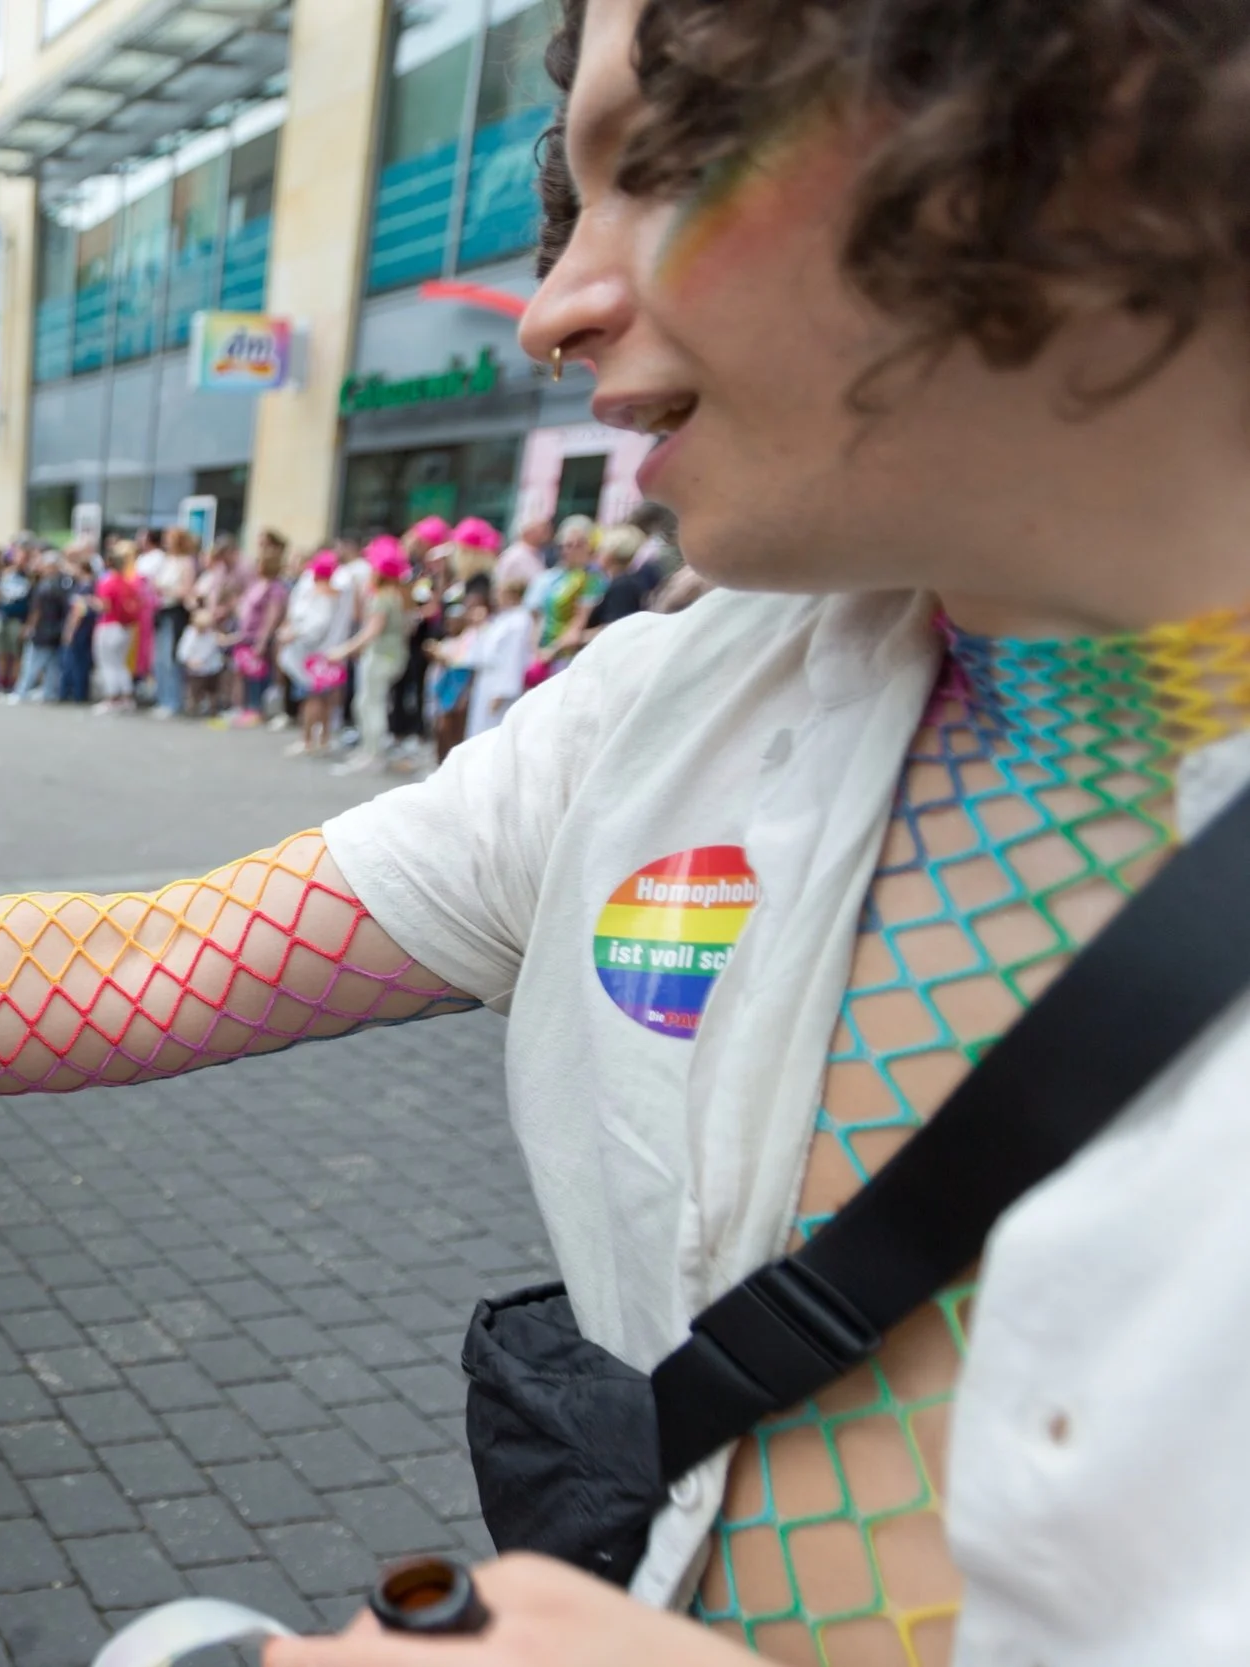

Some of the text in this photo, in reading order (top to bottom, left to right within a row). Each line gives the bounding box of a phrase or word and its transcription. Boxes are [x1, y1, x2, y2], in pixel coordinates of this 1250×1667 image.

[636, 877, 760, 907] Homophobi
[607, 940, 644, 965] ist
[649, 944, 695, 969] voll
